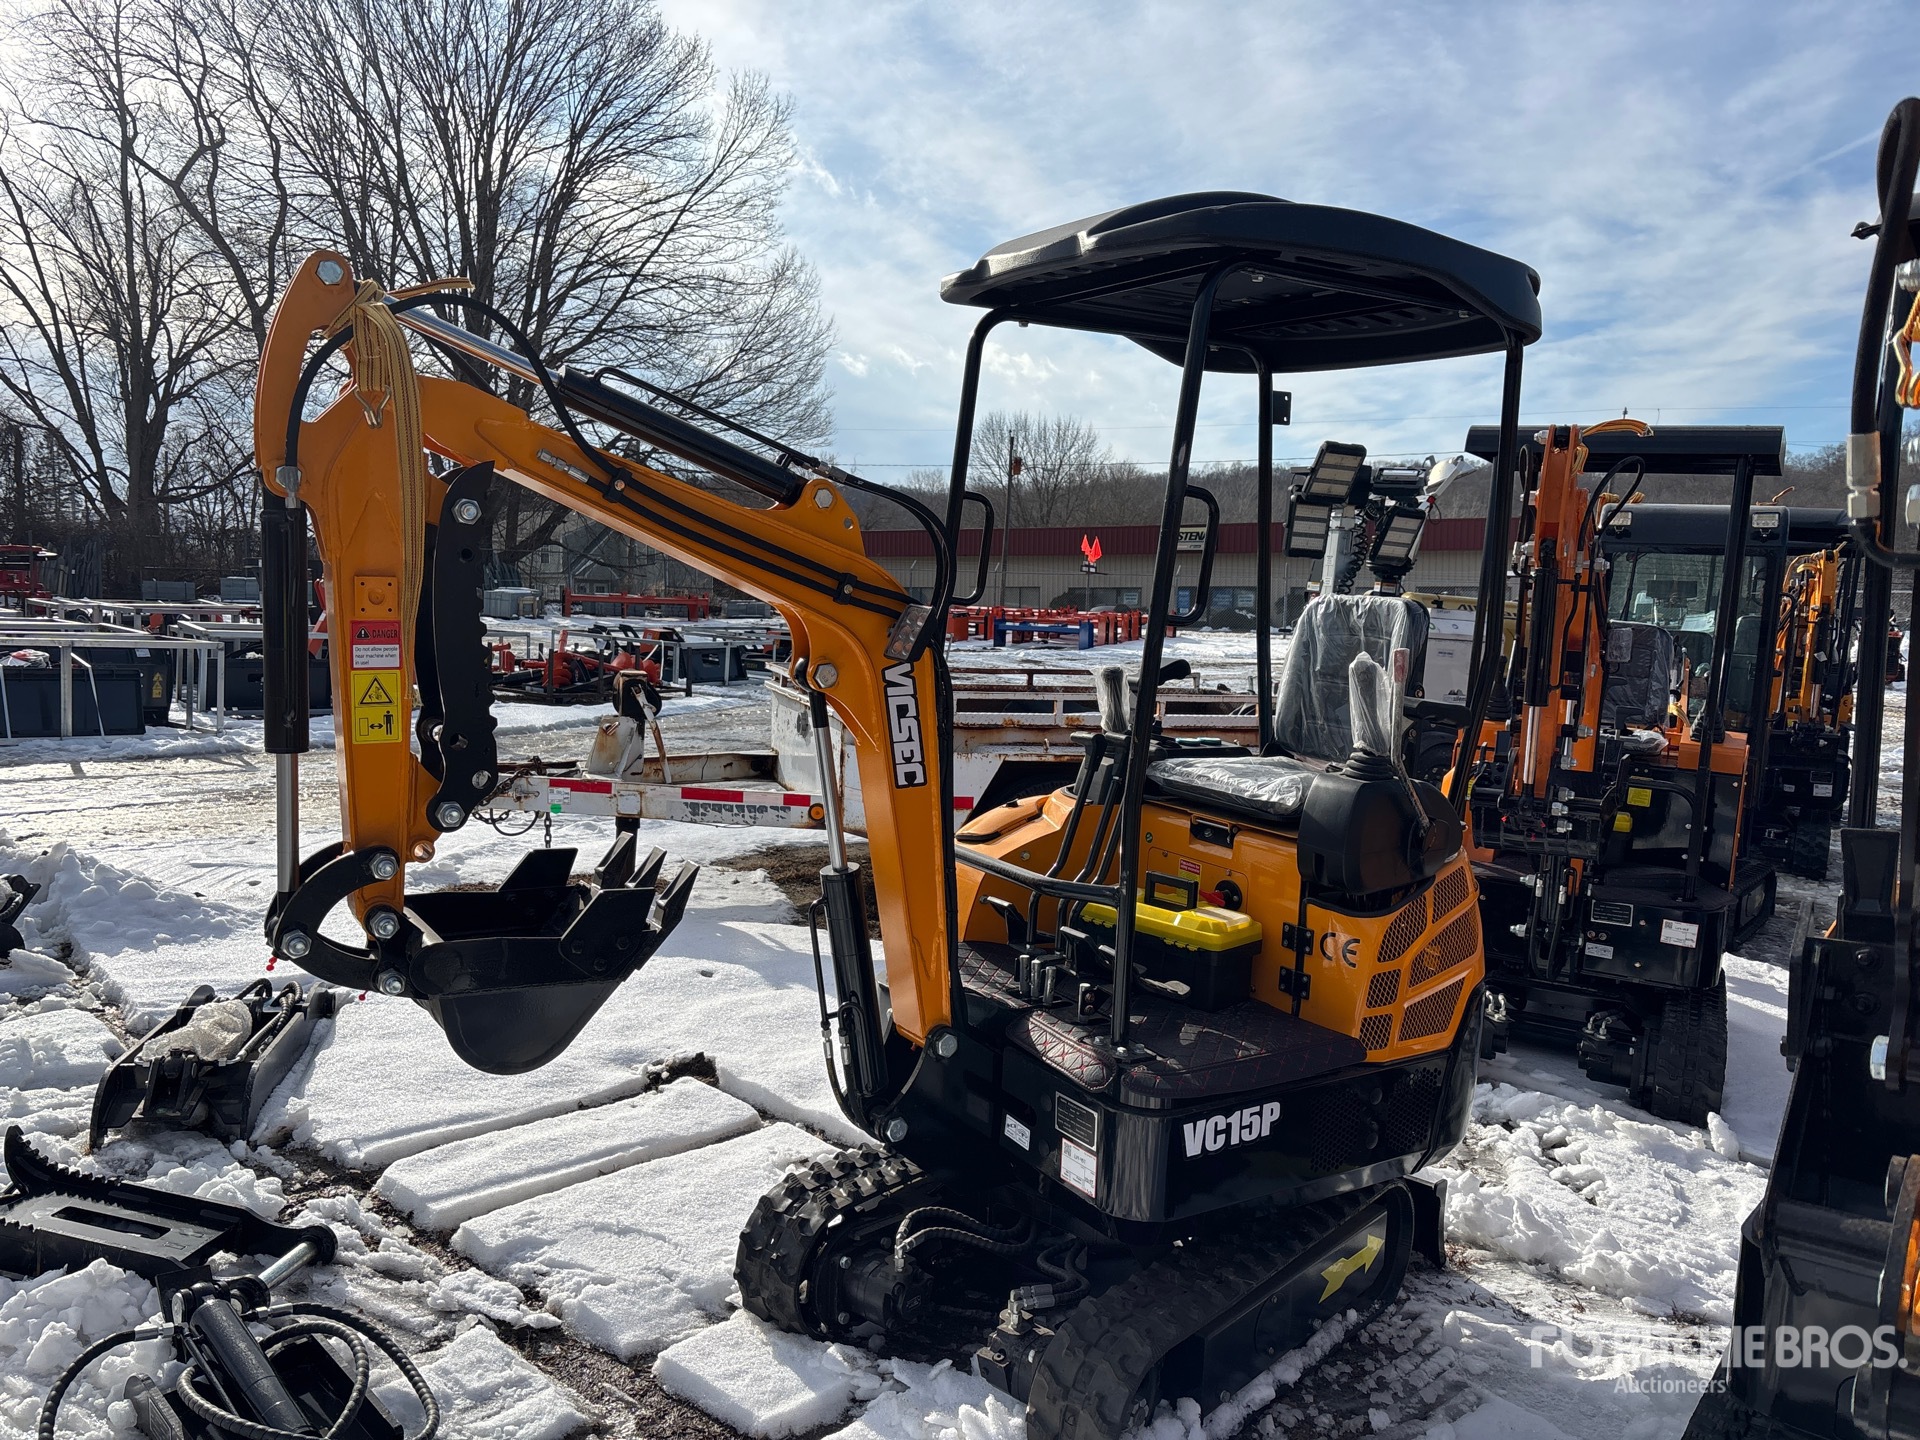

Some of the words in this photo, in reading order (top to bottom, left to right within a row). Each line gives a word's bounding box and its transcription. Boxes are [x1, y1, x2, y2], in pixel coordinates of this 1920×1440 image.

[372, 629, 398, 638] DANGER
[884, 662, 926, 787] VICSEC
[1319, 931, 1361, 969] CE
[1183, 1101, 1281, 1158] VC15P
